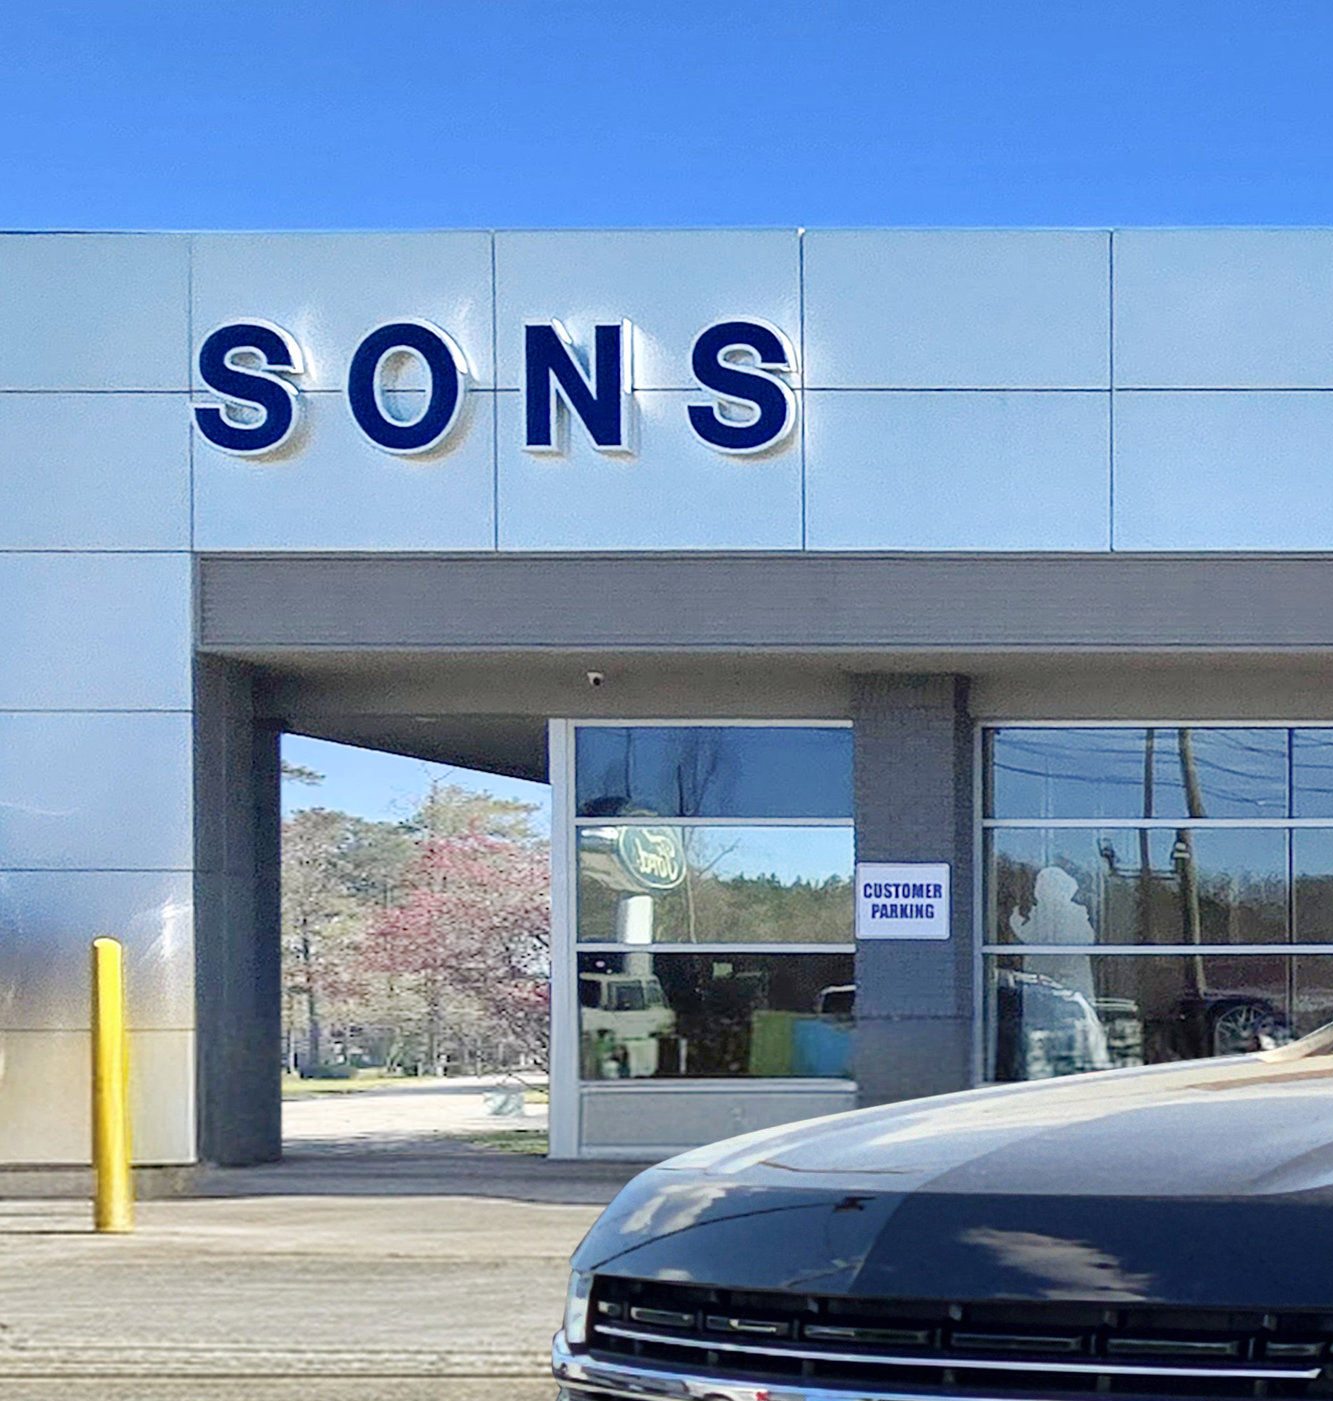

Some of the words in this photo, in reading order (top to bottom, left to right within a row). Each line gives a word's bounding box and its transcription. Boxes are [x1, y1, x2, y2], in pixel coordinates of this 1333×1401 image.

[194, 321, 792, 451] SONS
[863, 882, 943, 899] CUSTOMER
[871, 903, 935, 919] PARKING
